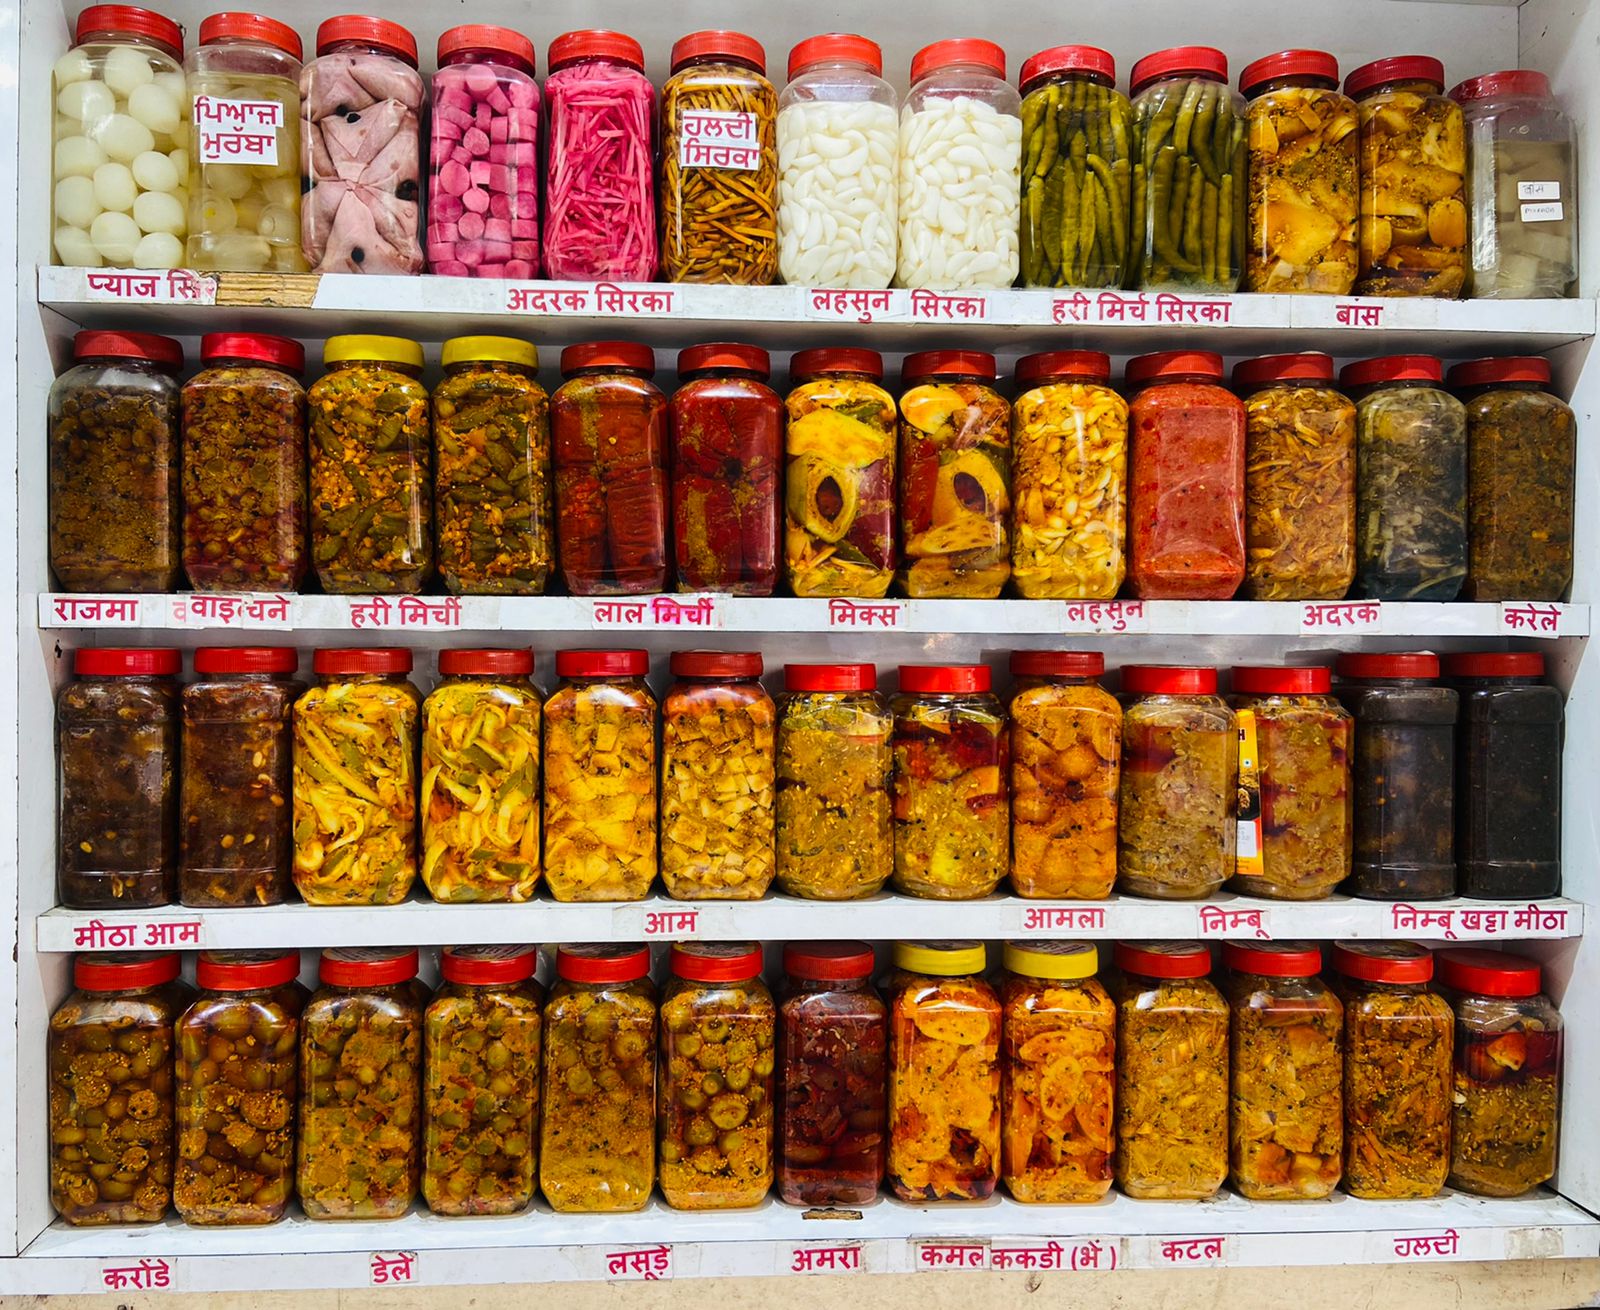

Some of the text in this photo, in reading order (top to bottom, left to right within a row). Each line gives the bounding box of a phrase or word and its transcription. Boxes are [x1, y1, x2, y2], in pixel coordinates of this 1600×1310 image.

[195, 95, 279, 125] ਪਿਆਜ਼
[684, 112, 753, 139] ਹਲਦੀ
[202, 126, 275, 159] ਮੁਰੱਬਾ
[684, 137, 760, 168] ਸਿਰਕਾ
[87, 273, 161, 298] प्याज
[507, 283, 675, 313] अदरक सिरका
[811, 289, 986, 324] लहसुन सिरका
[1052, 292, 1233, 323] हरी मिर्च सिरका
[1336, 298, 1384, 326] बांस
[54, 598, 139, 622] राजमा
[350, 596, 462, 628] हरी मिर्ची
[593, 597, 714, 625] लाल मिर्ची
[828, 599, 900, 627] मिक्स
[1066, 600, 1146, 631] लहसुन
[1303, 602, 1381, 627] अदरक
[1504, 603, 1562, 631] करेले
[645, 911, 699, 935] आम
[1024, 908, 1105, 929] आमला
[1199, 905, 1270, 939] निम्बू
[1392, 903, 1568, 939] निम्बू खट्टा मीठा
[74, 919, 202, 948] मीठा आम
[921, 1245, 984, 1267] कमल
[991, 1241, 1064, 1269] ककडी
[1162, 1238, 1225, 1262] कटल
[1393, 1228, 1460, 1257] ਹਲਦੀ
[791, 1246, 861, 1272] अमरा
